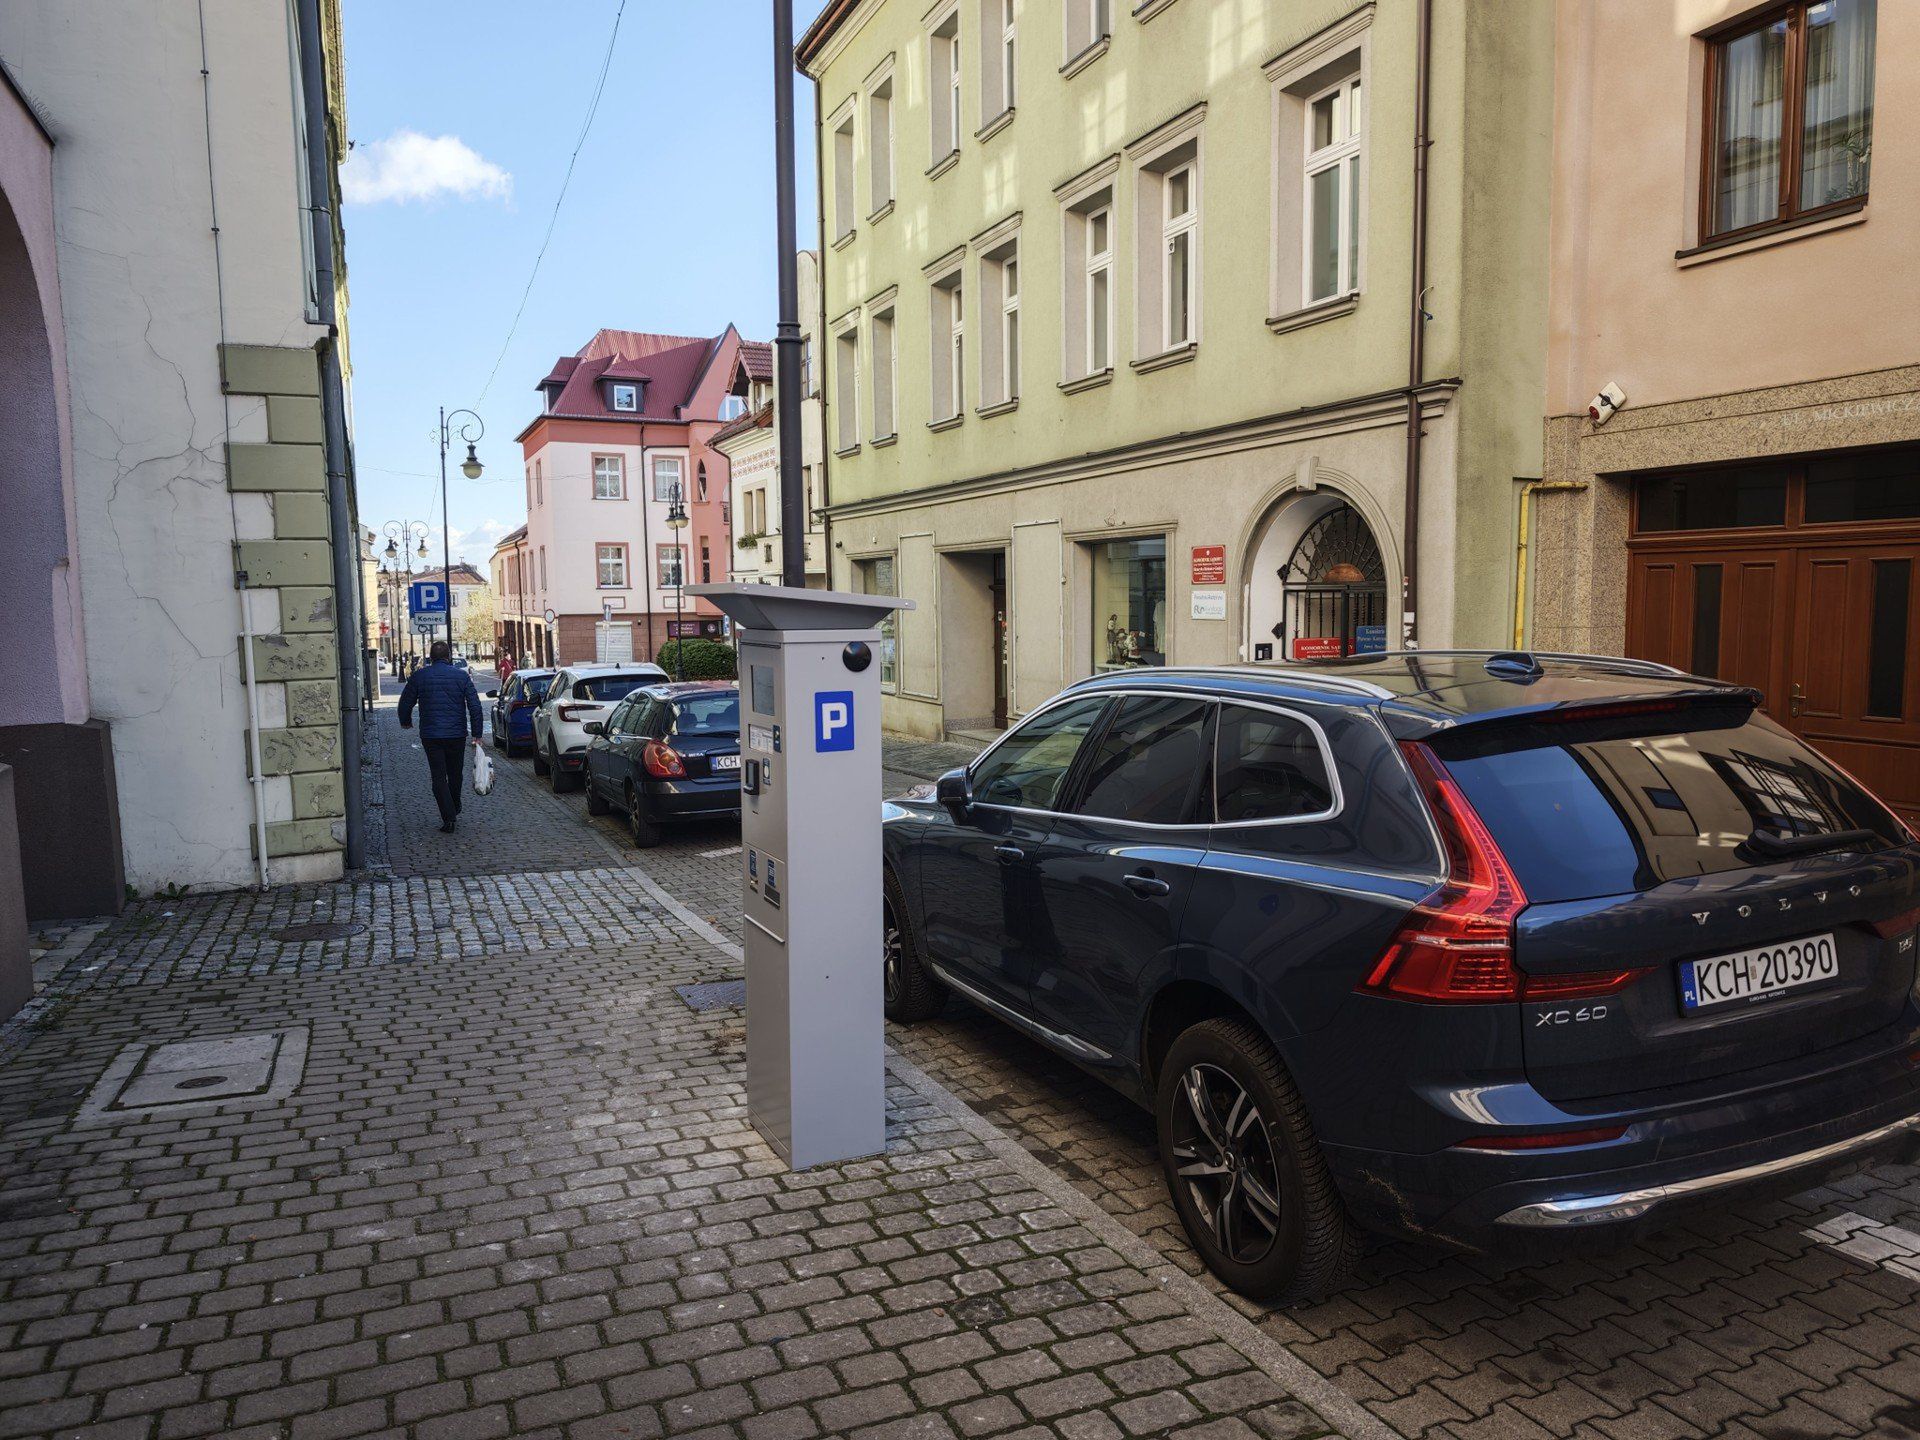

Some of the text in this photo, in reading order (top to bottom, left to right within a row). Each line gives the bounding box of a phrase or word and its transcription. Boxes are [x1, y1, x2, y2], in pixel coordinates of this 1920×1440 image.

[420, 585, 440, 609] P
[821, 702, 848, 740] P
[717, 756, 738, 768] KCH
[1691, 885, 1862, 926] VOLVO
[1684, 938, 1834, 1002] PL KCH 20390
